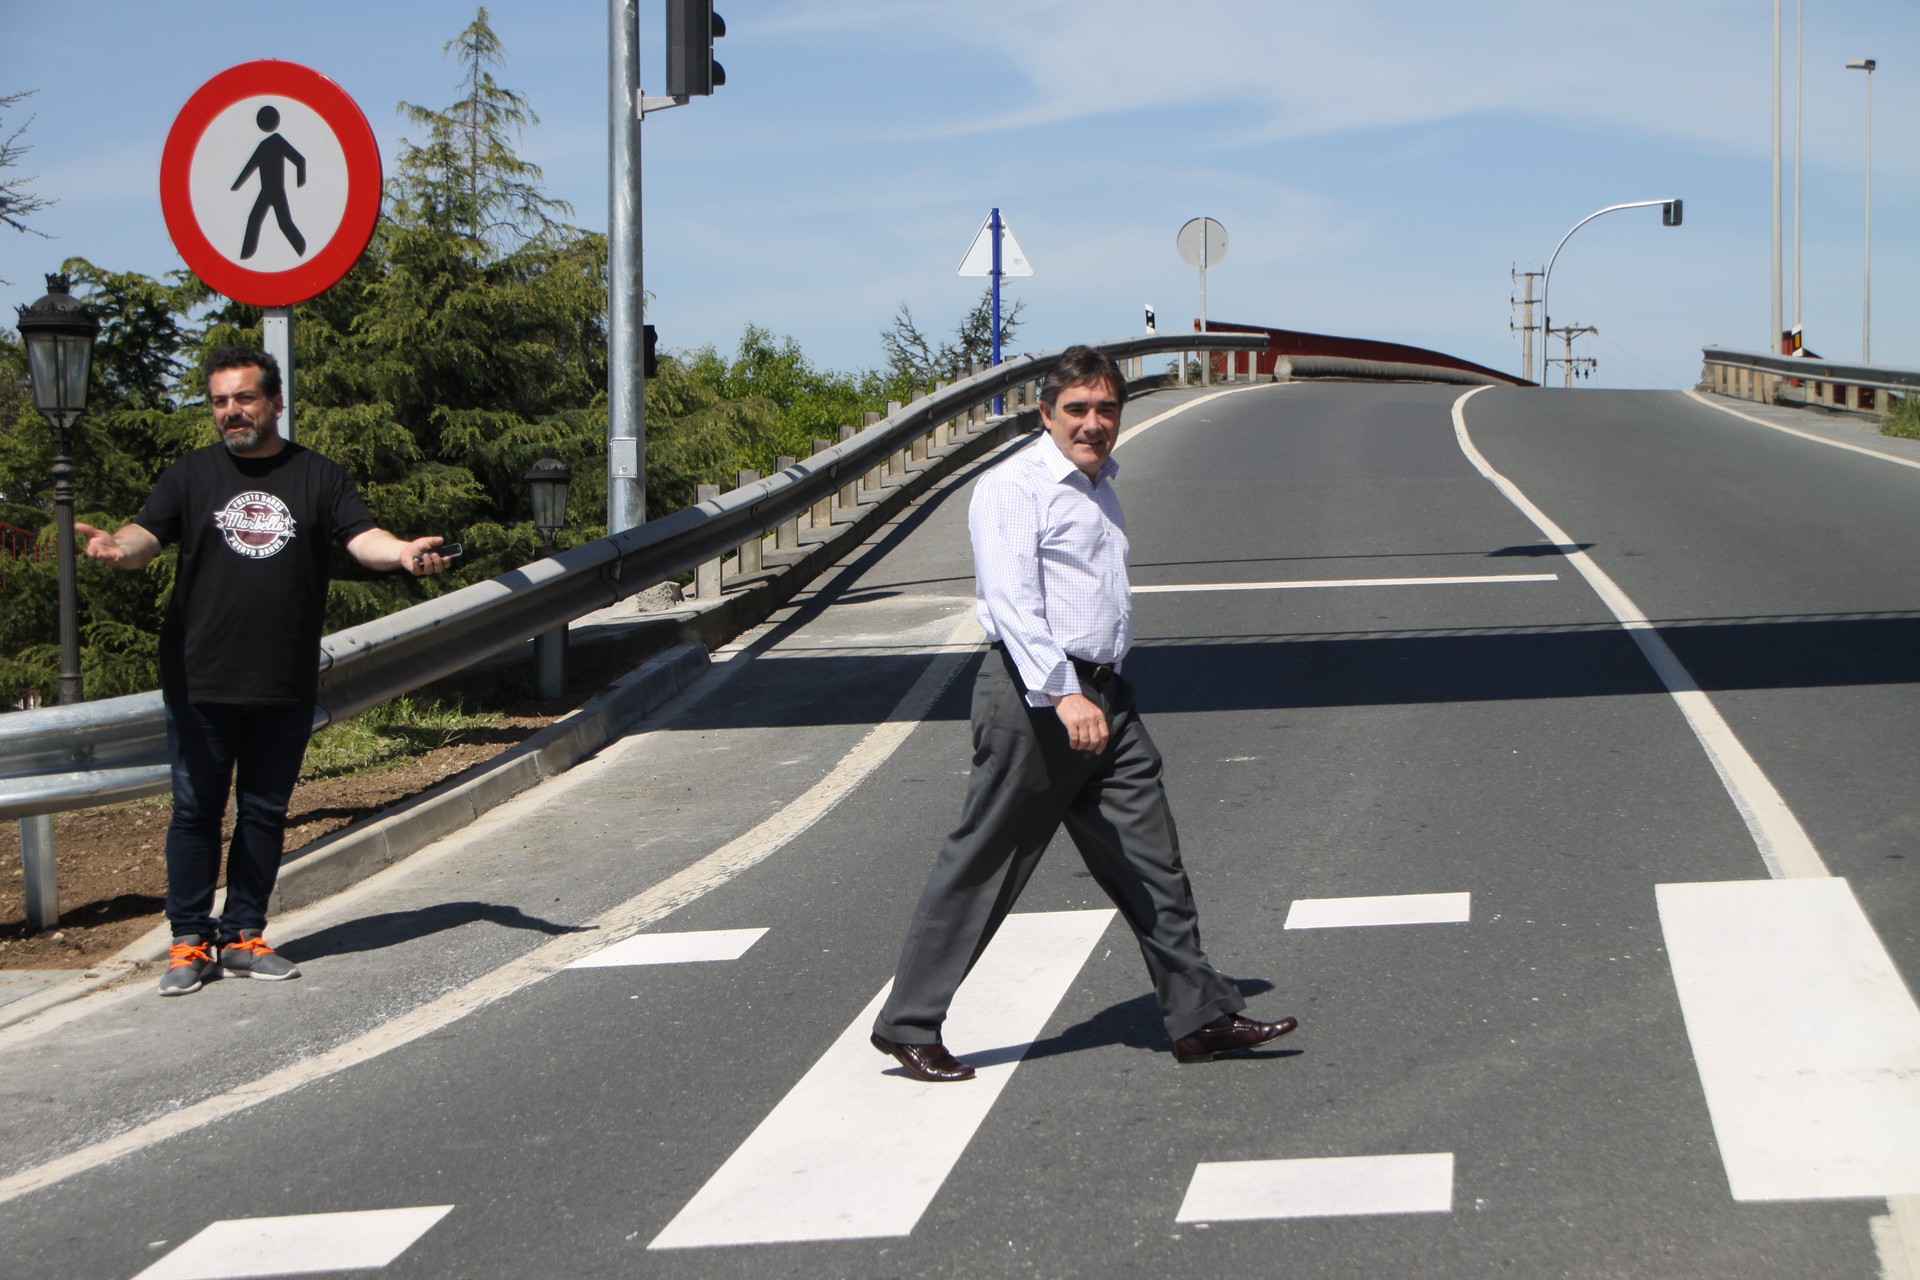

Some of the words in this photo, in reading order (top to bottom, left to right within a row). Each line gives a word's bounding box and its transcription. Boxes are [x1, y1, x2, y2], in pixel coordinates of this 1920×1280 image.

[232, 494, 260, 509] PUERTO
[225, 511, 286, 531] Marbella
[229, 536, 257, 556] PUERTO
